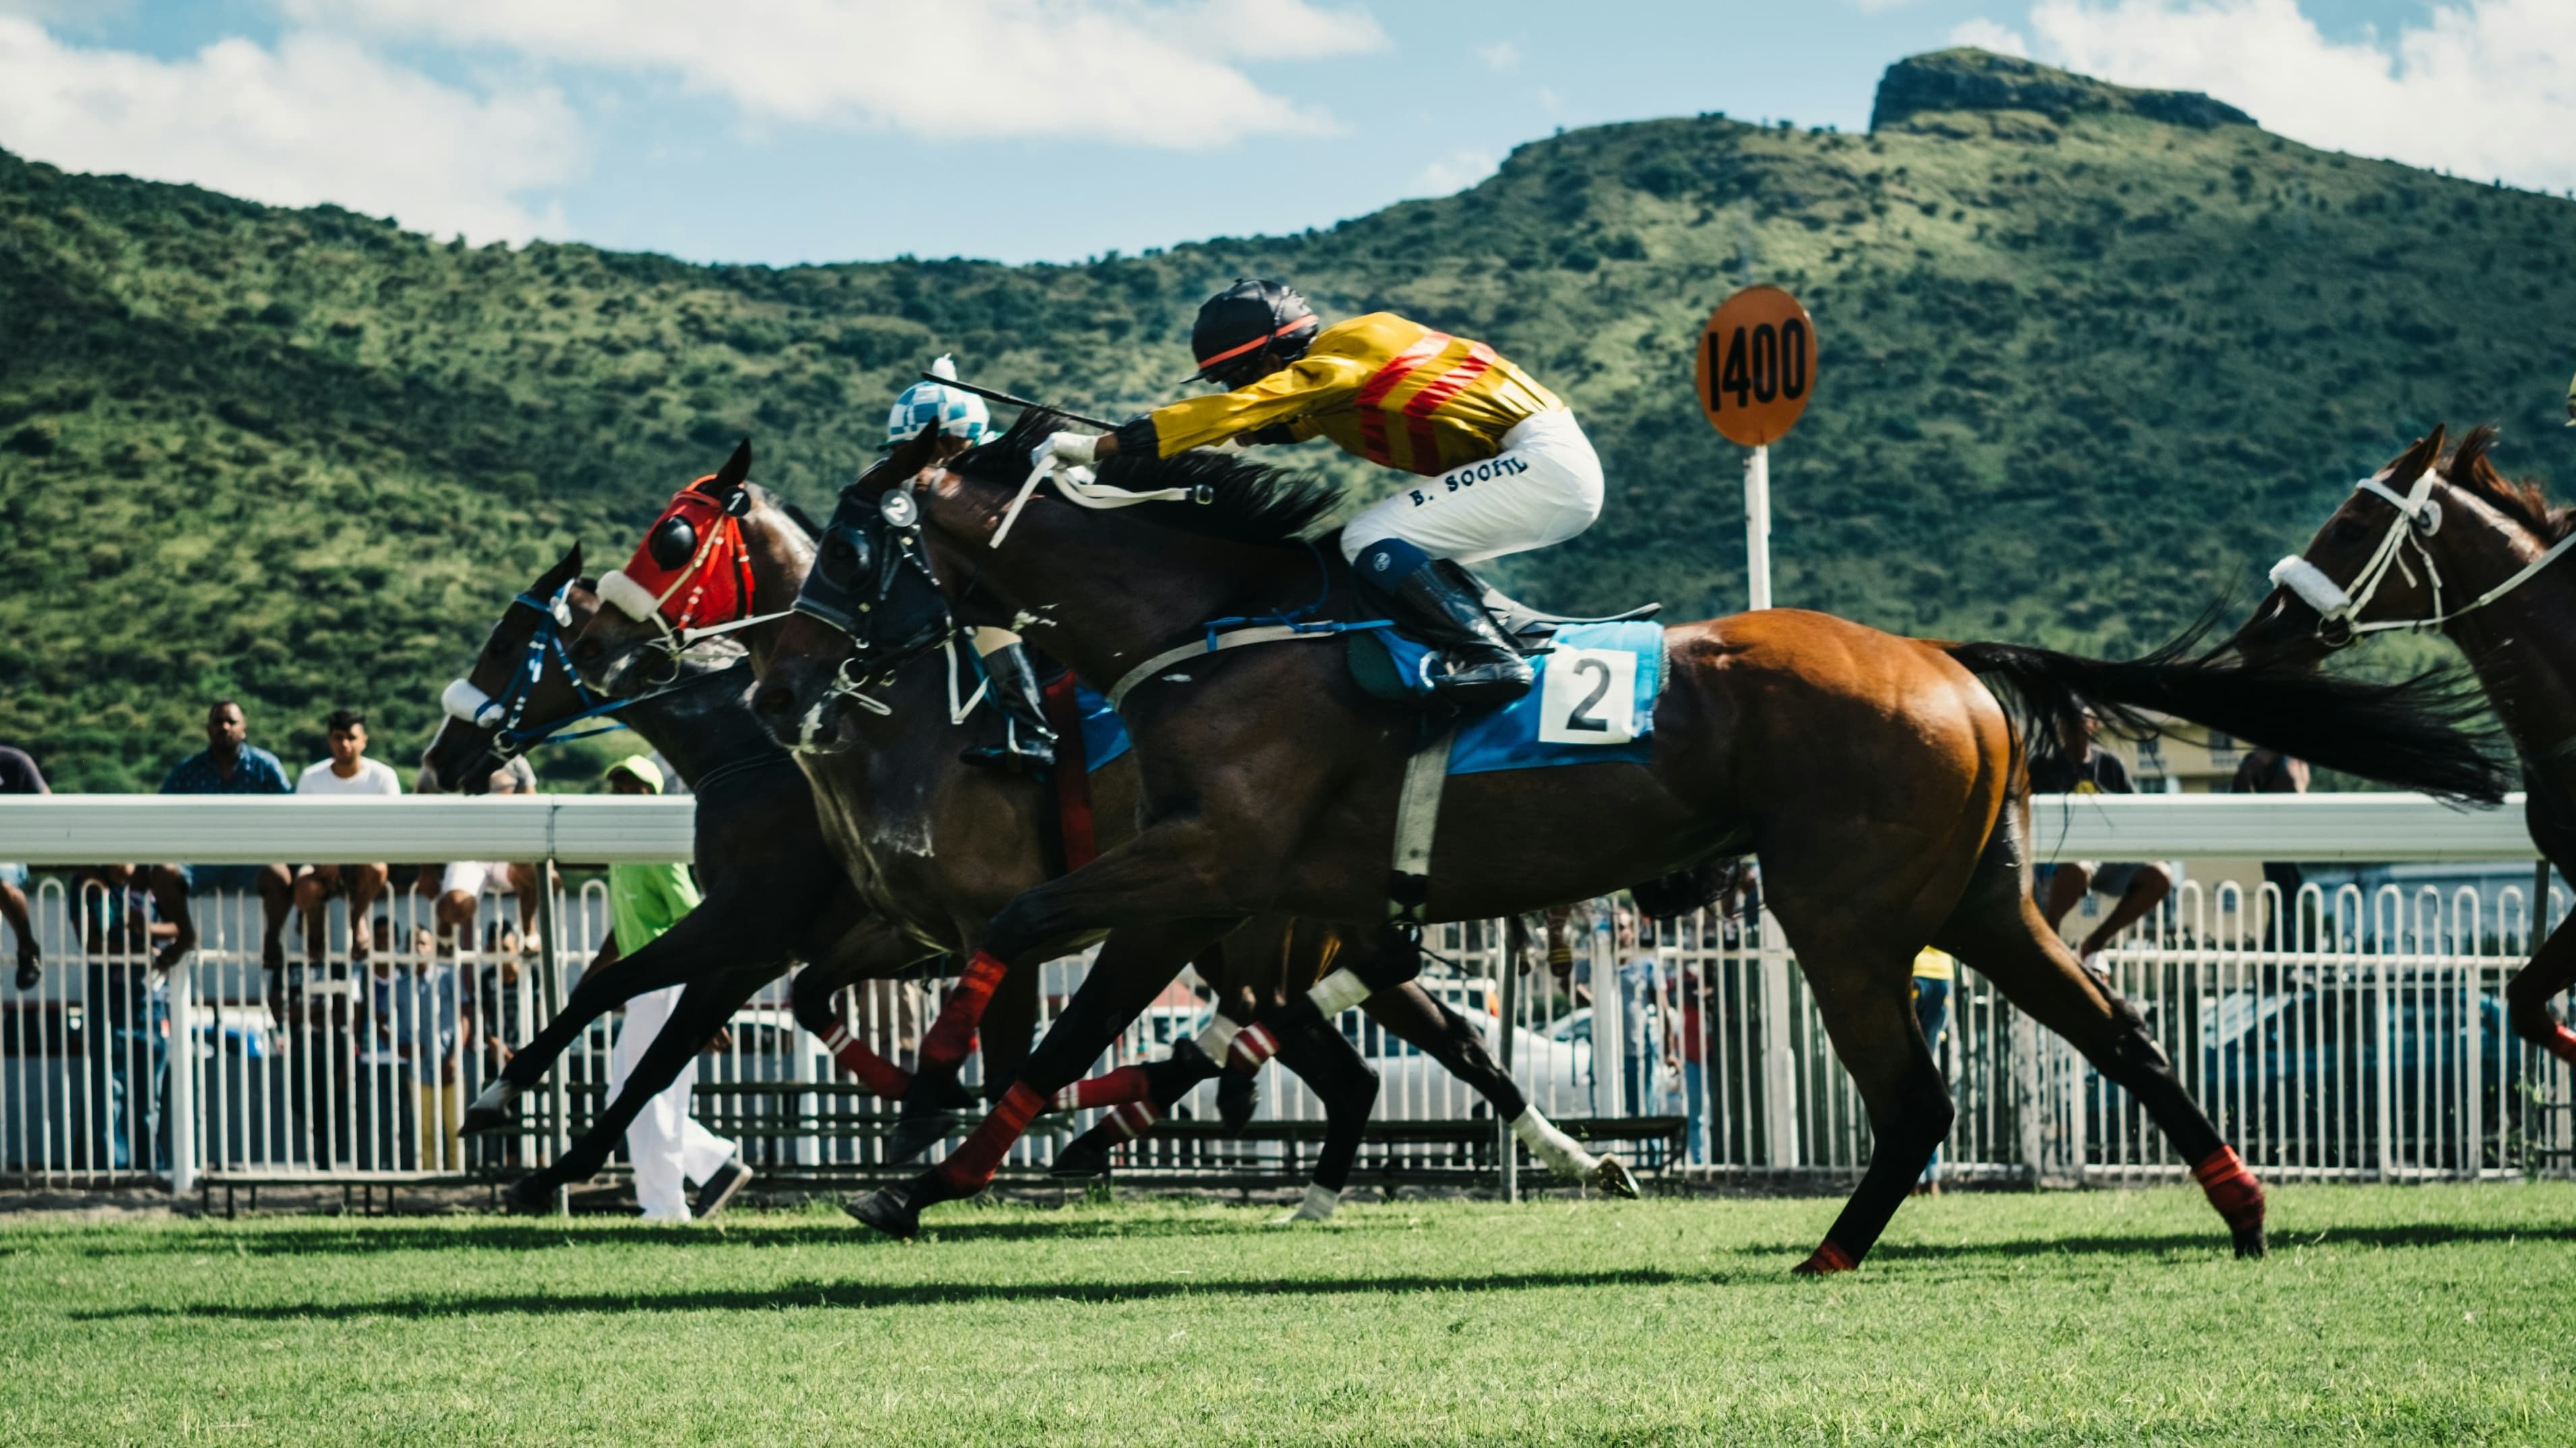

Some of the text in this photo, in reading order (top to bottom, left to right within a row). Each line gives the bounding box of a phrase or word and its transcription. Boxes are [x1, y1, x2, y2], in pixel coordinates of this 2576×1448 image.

[1708, 318, 1805, 413] 1400
[728, 492, 744, 512] 1
[885, 497, 909, 521] 2
[1409, 489, 1434, 507] B.
[1566, 658, 1610, 732] 2
